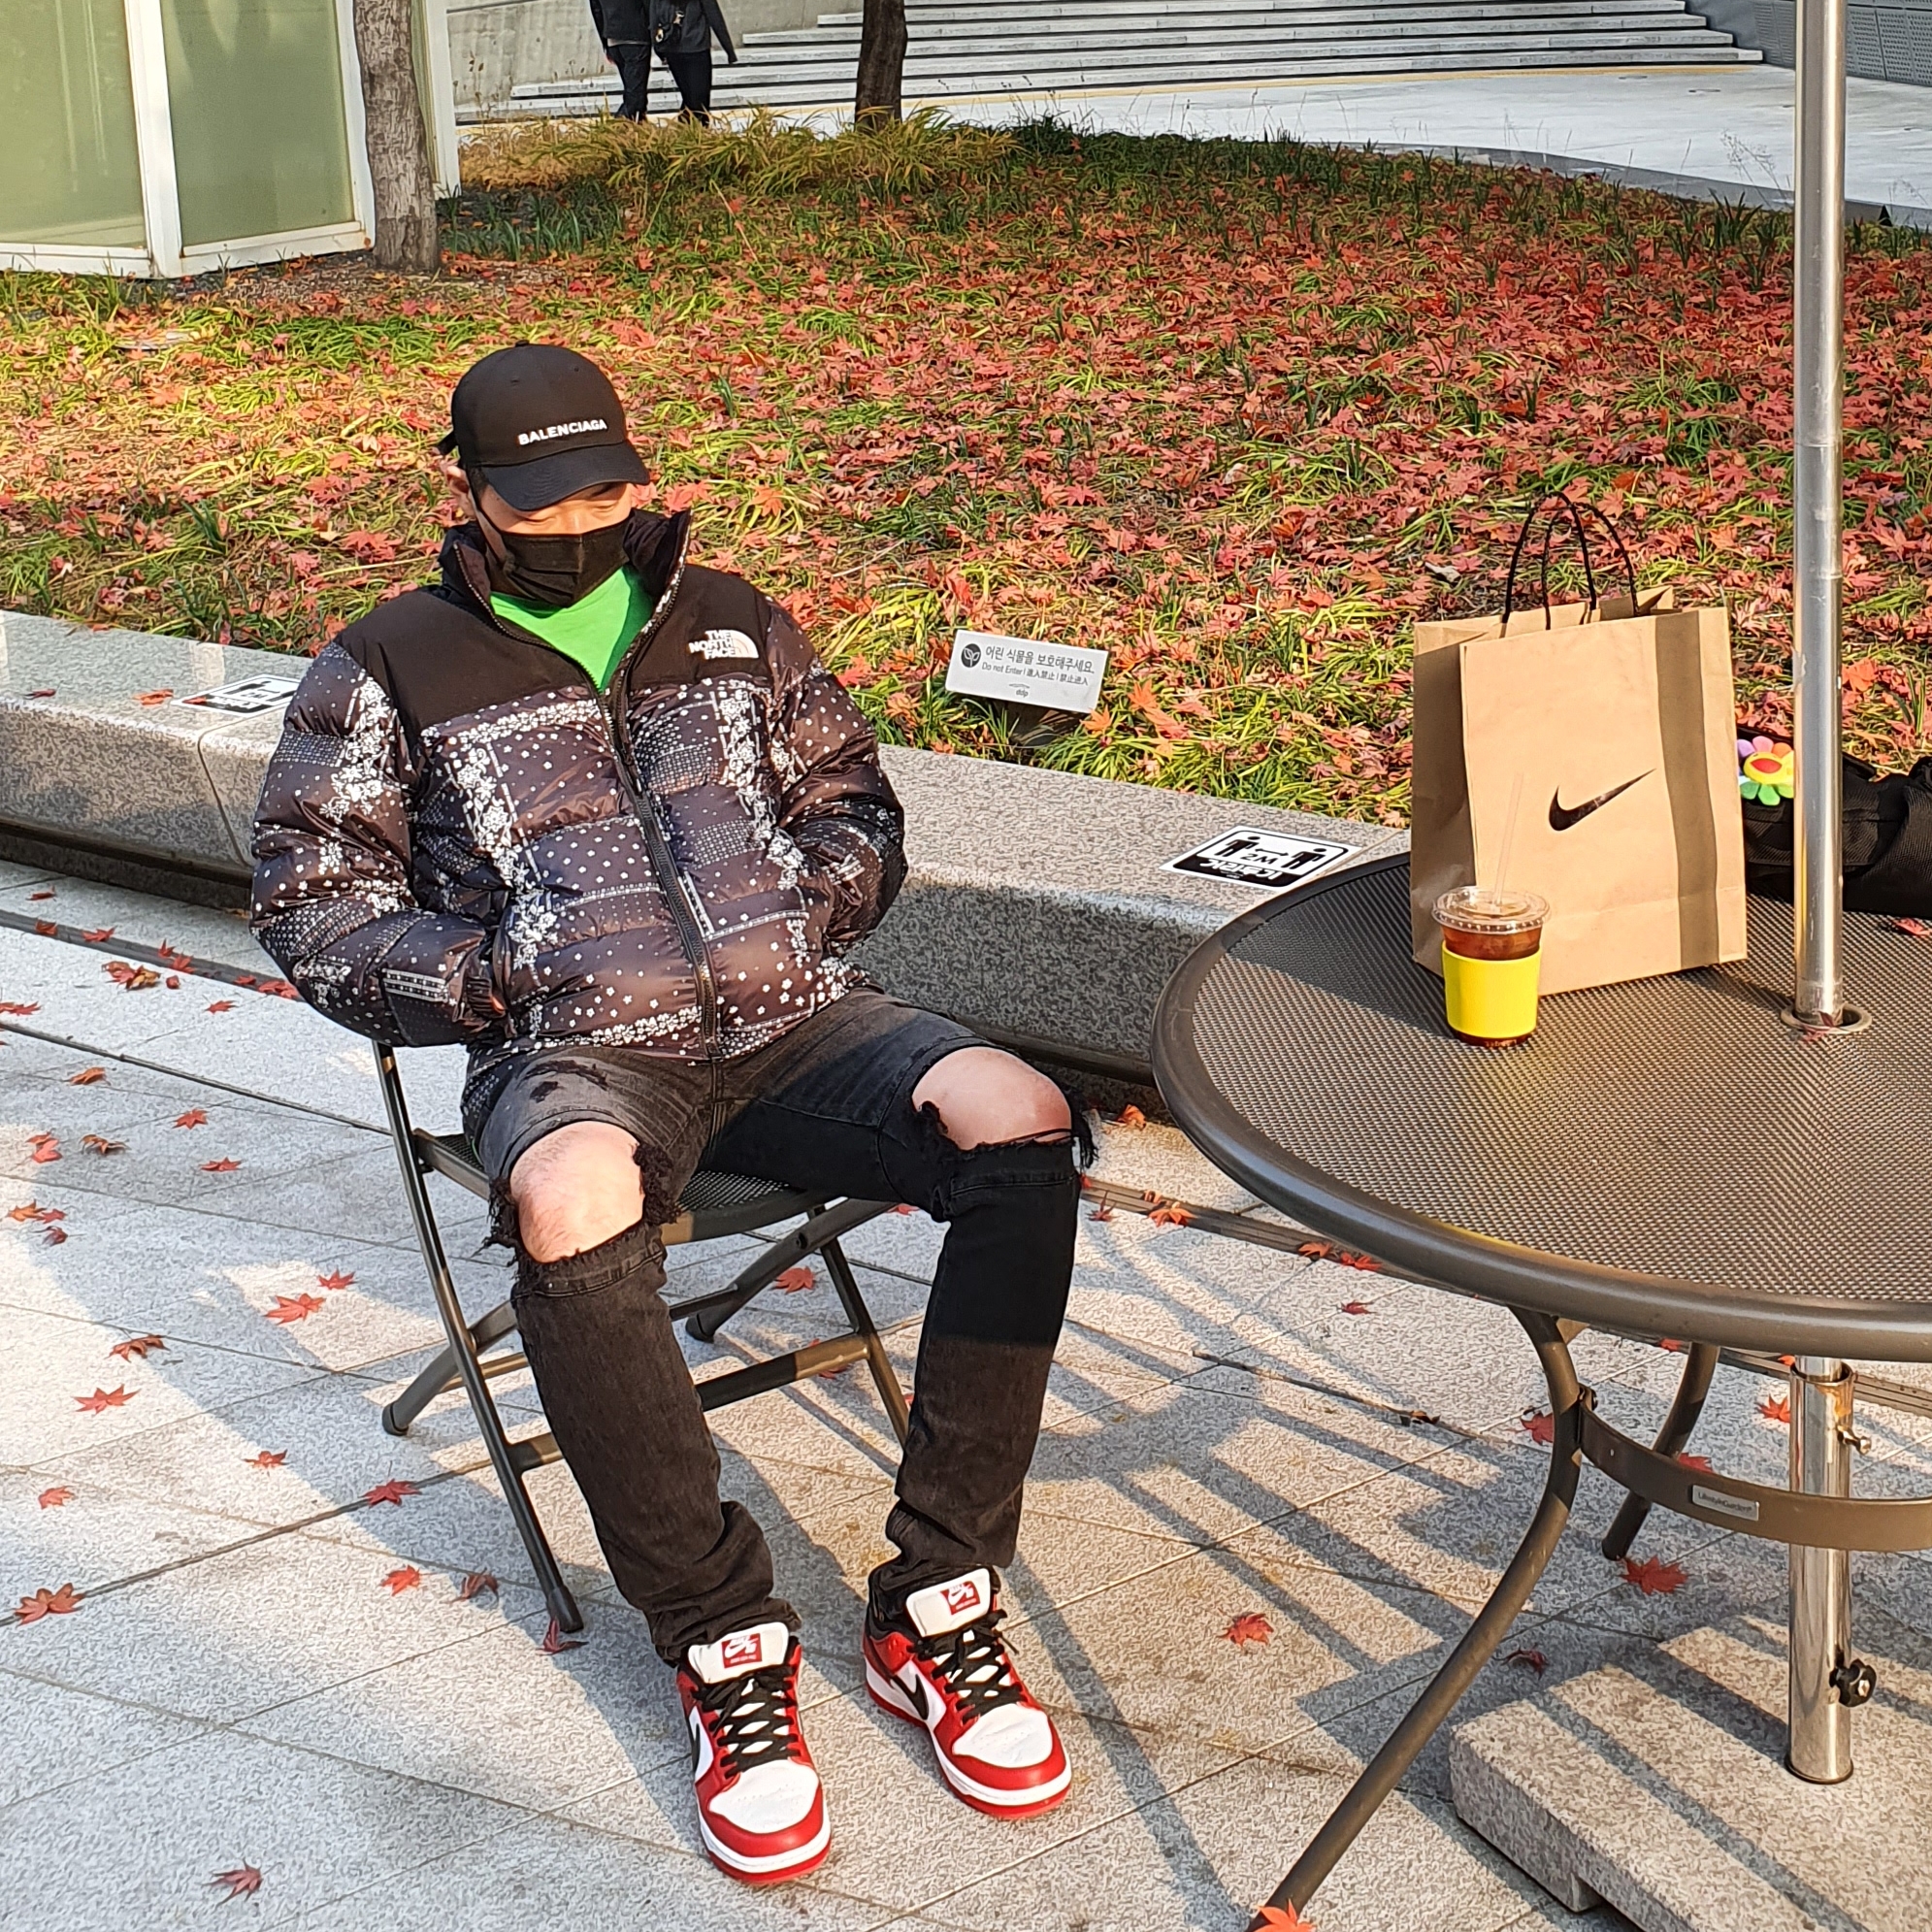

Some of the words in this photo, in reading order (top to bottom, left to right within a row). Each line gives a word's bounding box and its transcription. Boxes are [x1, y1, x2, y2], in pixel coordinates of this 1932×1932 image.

[518, 419, 607, 445] BALENCIAGA
[704, 630, 733, 640] THE
[688, 638, 735, 654] NORTH
[704, 648, 737, 660] FACE
[985, 645, 1004, 660] 어린
[1006, 648, 1034, 665] 식물을
[981, 661, 992, 671] Do
[1004, 665, 1023, 675] Enter
[1240, 853, 1278, 865] 2M
